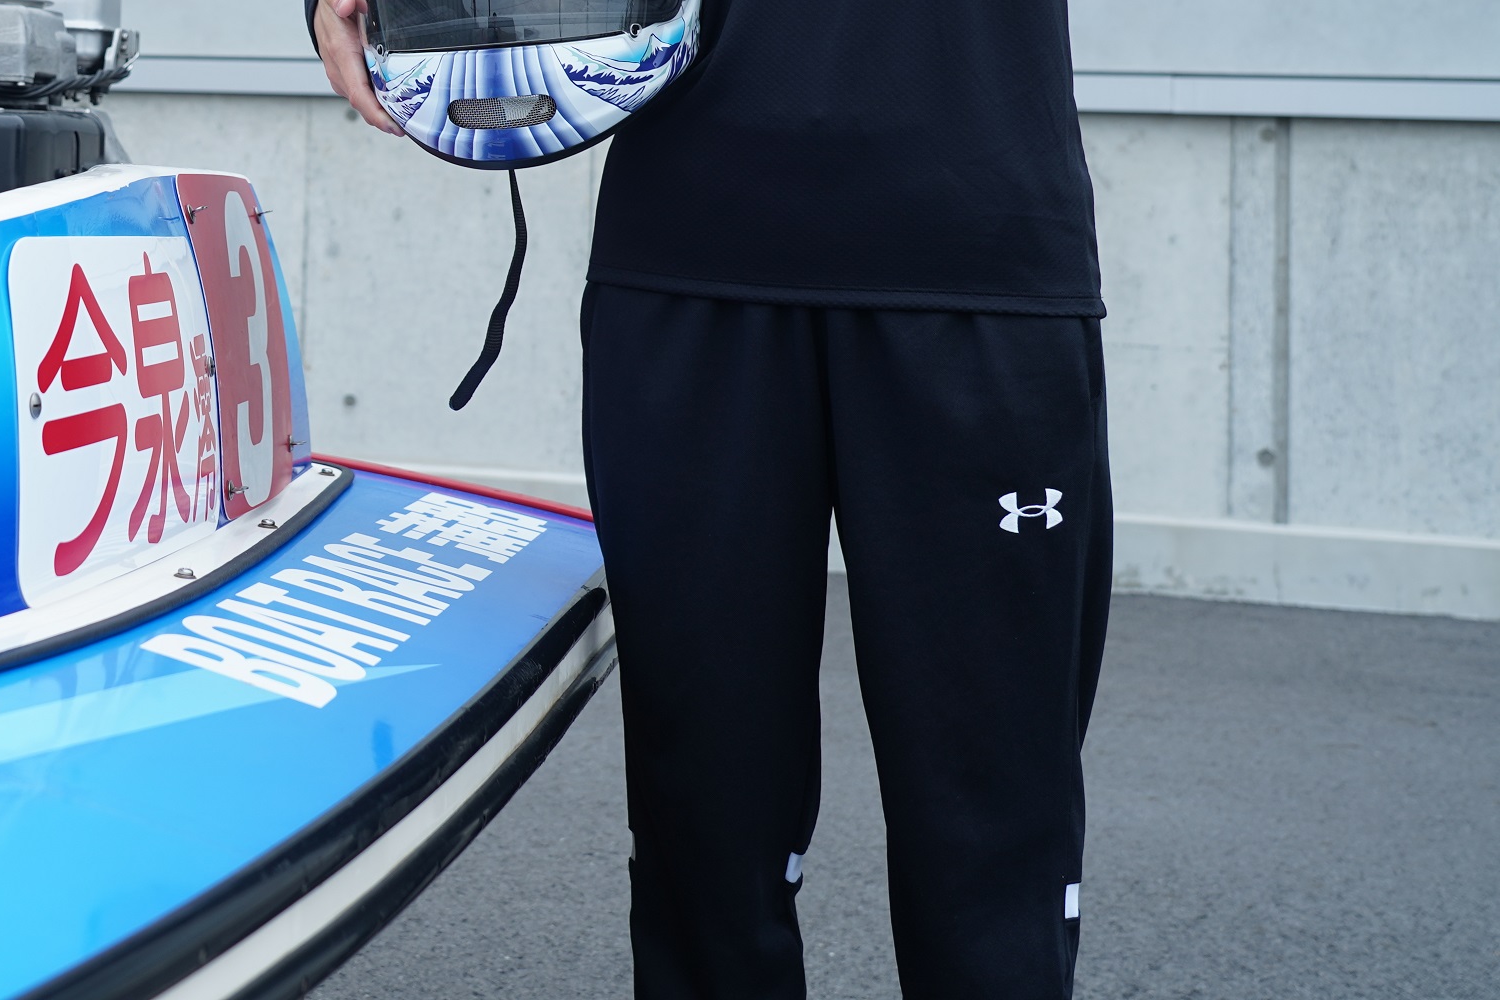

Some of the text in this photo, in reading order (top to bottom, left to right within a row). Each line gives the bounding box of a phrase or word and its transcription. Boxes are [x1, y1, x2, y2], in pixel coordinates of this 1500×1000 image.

[223, 190, 276, 509] 3
[138, 491, 549, 709] BOAT RACE 蒲郡
